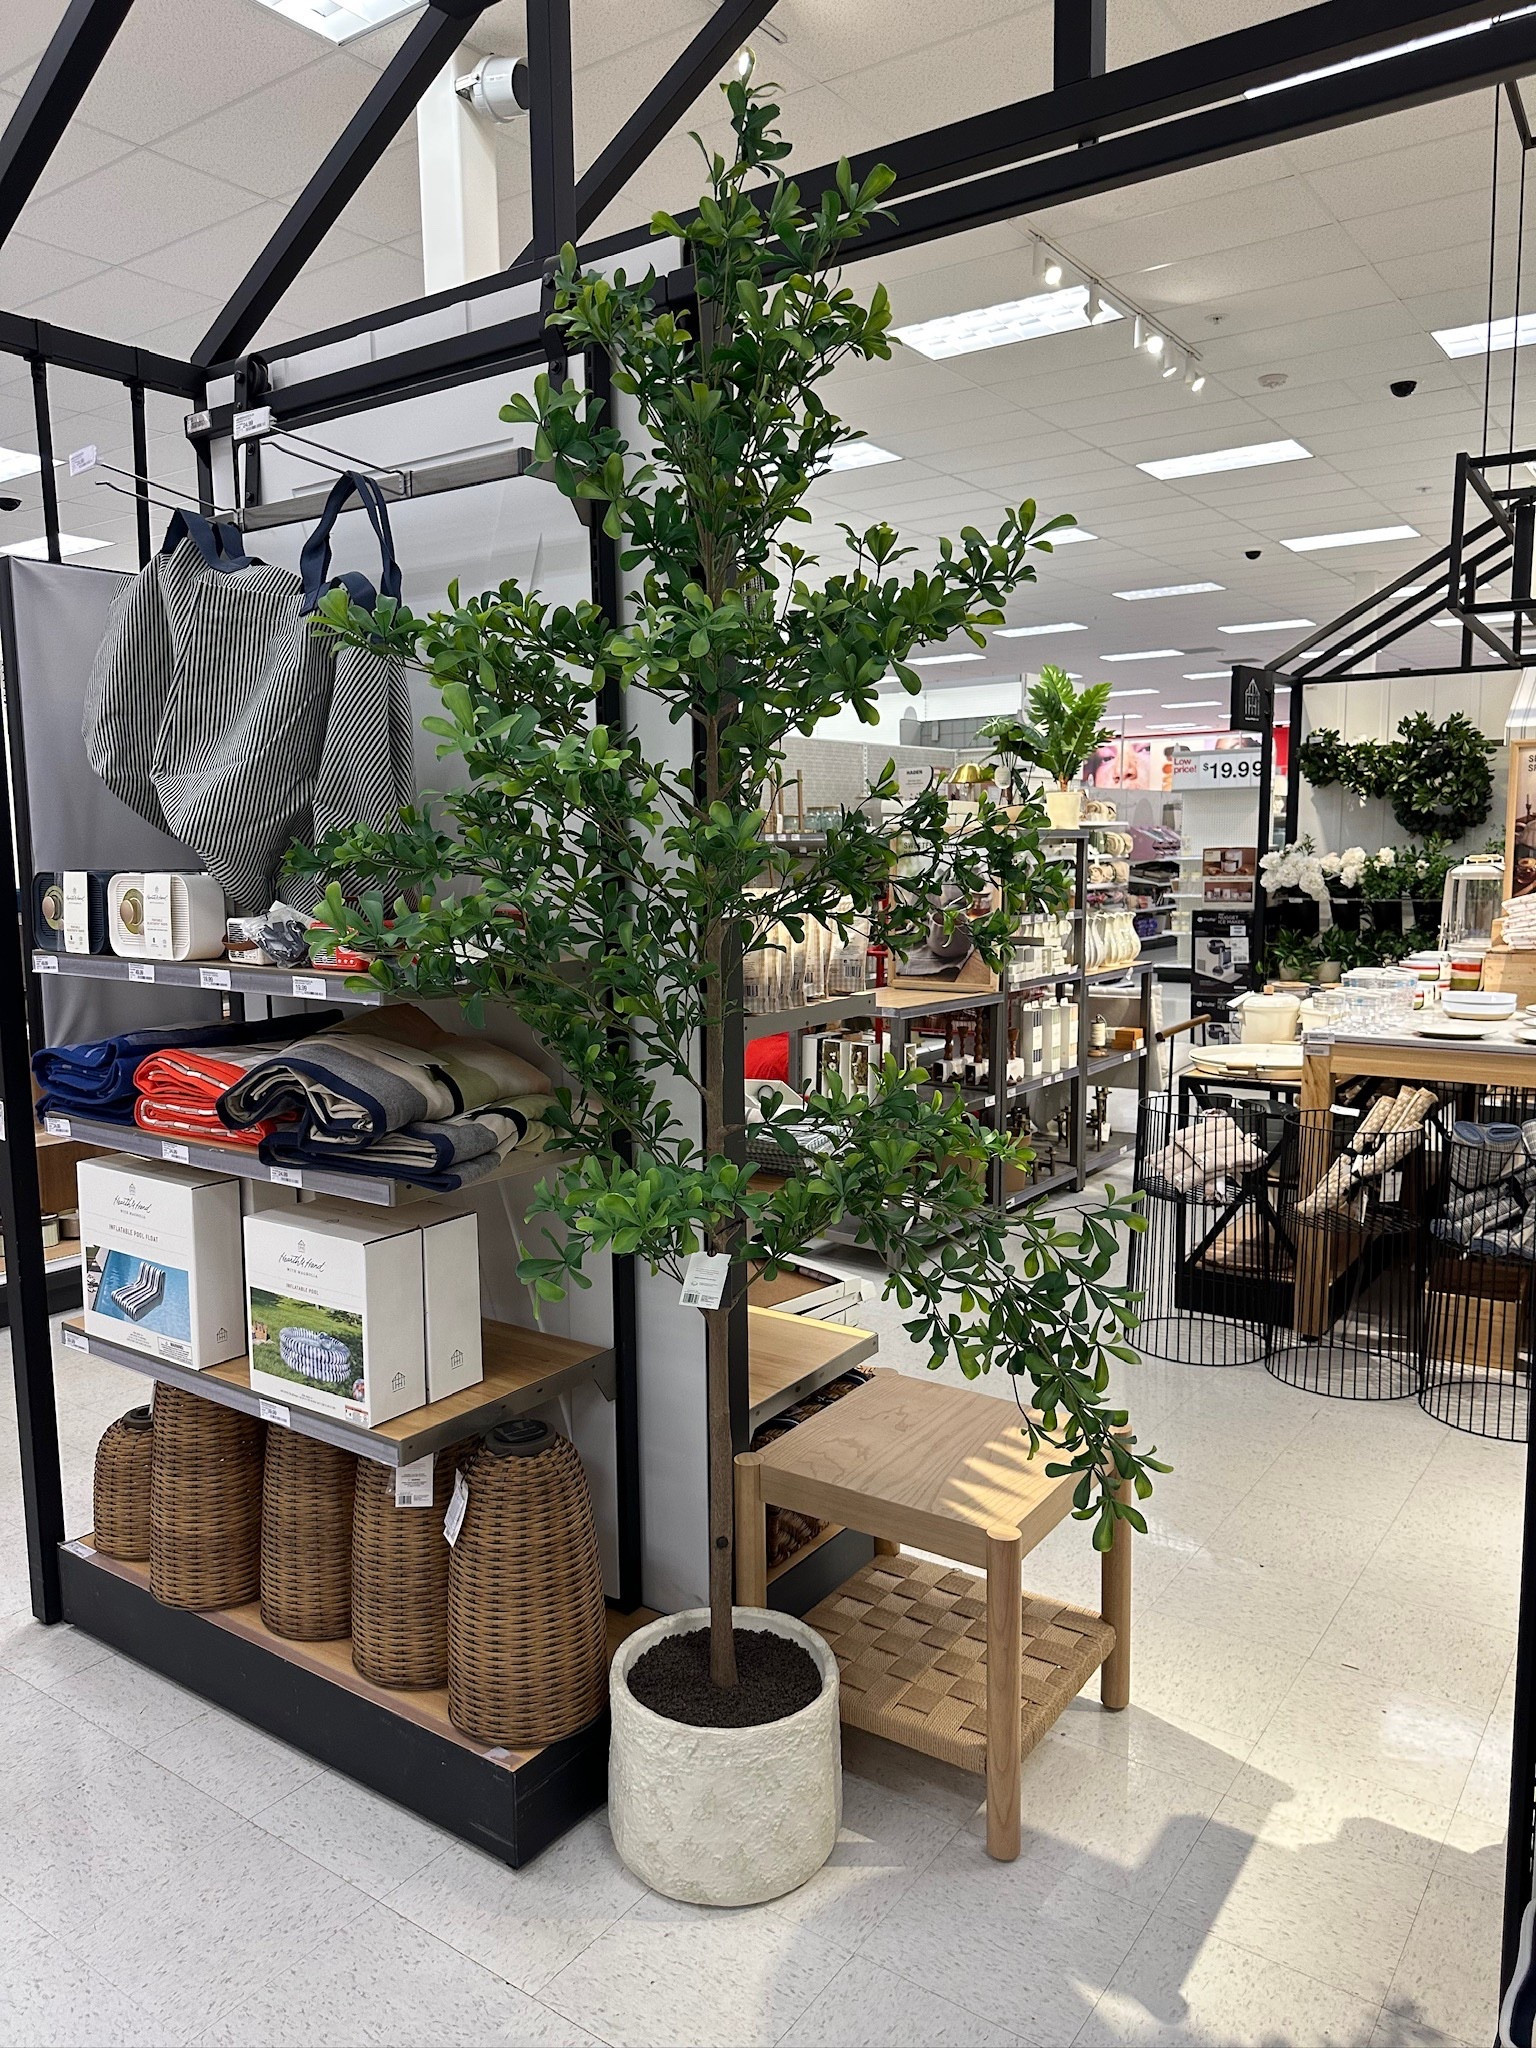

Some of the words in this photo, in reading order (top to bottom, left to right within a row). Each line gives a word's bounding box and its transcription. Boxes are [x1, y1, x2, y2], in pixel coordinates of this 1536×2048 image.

[1173, 758, 1191, 766] Low
[1203, 761, 1261, 778] $19.99
[1173, 766, 1197, 775] price!
[109, 1224, 133, 1236] INFLATABLE
[133, 1230, 145, 1240] POOL
[145, 1234, 159, 1242] FLOAT
[279, 1252, 302, 1266] Hearth
[304, 1258, 326, 1272] Hand
[286, 1283, 308, 1292] INFLATABLE
[308, 1288, 319, 1296] POOL
